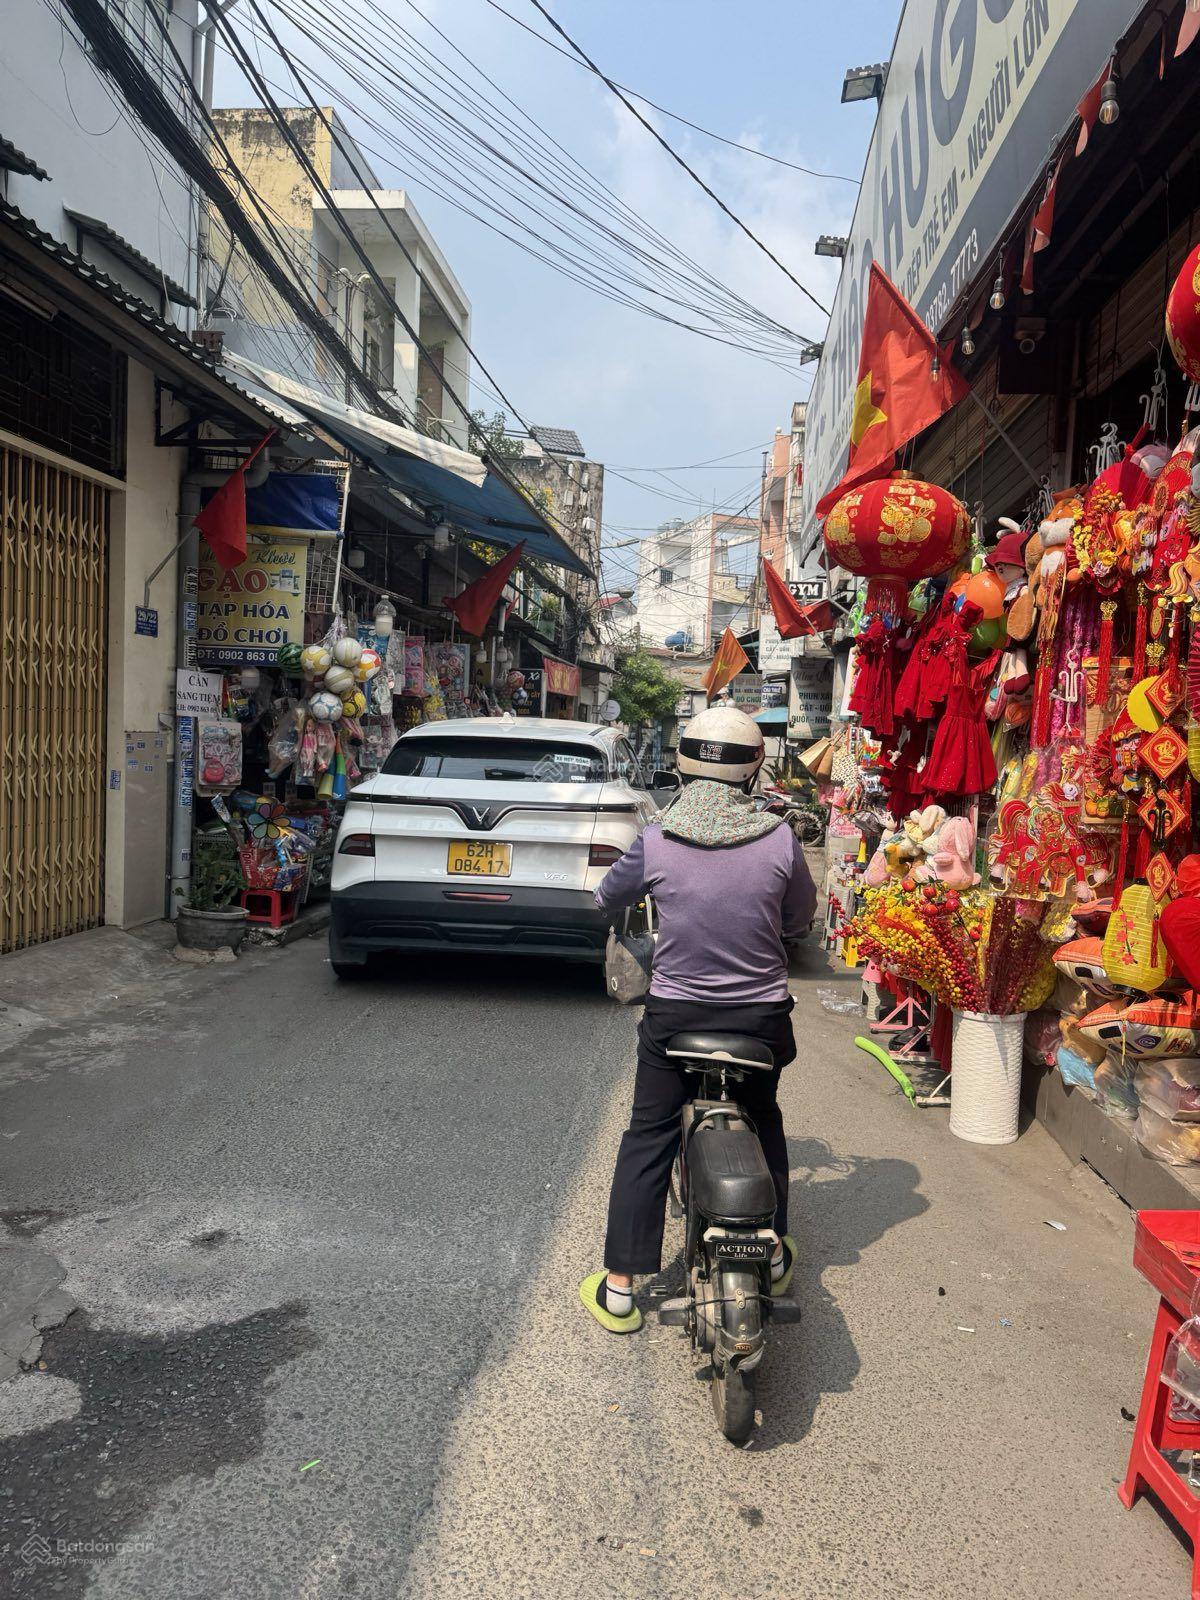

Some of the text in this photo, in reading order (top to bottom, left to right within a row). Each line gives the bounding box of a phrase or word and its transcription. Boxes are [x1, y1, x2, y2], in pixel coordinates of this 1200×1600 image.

[941, 167, 959, 233] EM
[789, 583, 820, 596] GYM
[198, 602, 237, 620] TẠP
[243, 601, 289, 620] HÓA
[197, 622, 288, 644] ĐỒ CHƠI
[218, 650, 244, 660] 0902
[247, 651, 265, 661] 863
[177, 691, 198, 702] SANG
[467, 843, 494, 858] 62H
[454, 858, 504, 874] 084.17
[719, 1245, 764, 1254] ACTION
